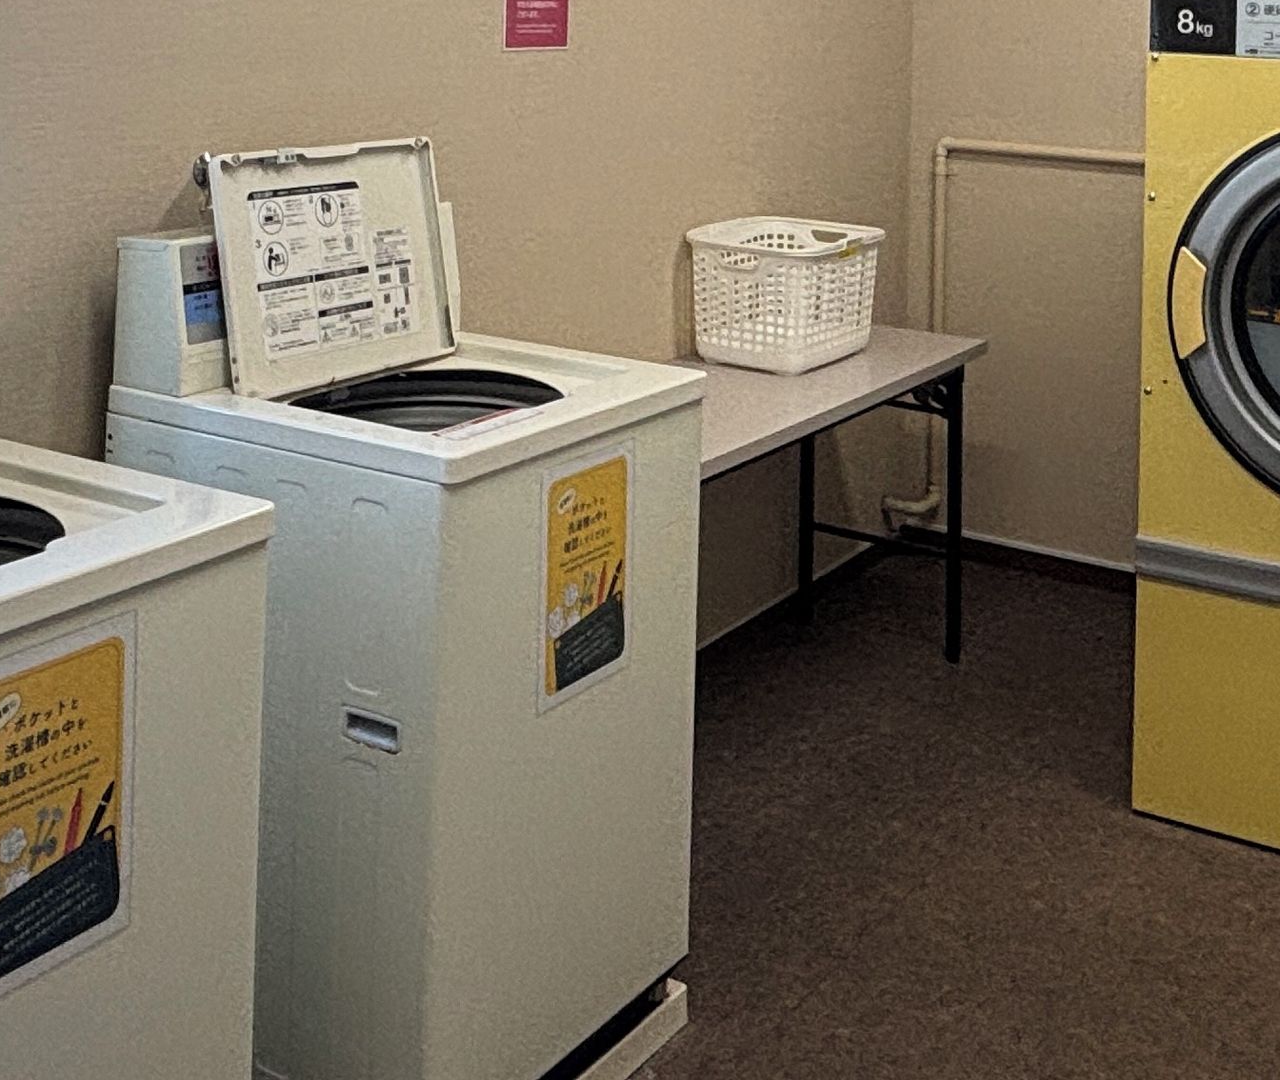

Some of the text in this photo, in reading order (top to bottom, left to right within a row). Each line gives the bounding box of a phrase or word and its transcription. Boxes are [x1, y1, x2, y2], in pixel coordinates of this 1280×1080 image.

[14, 698, 79, 732] ポケットと
[4, 717, 88, 762] 洗濯槽の中を
